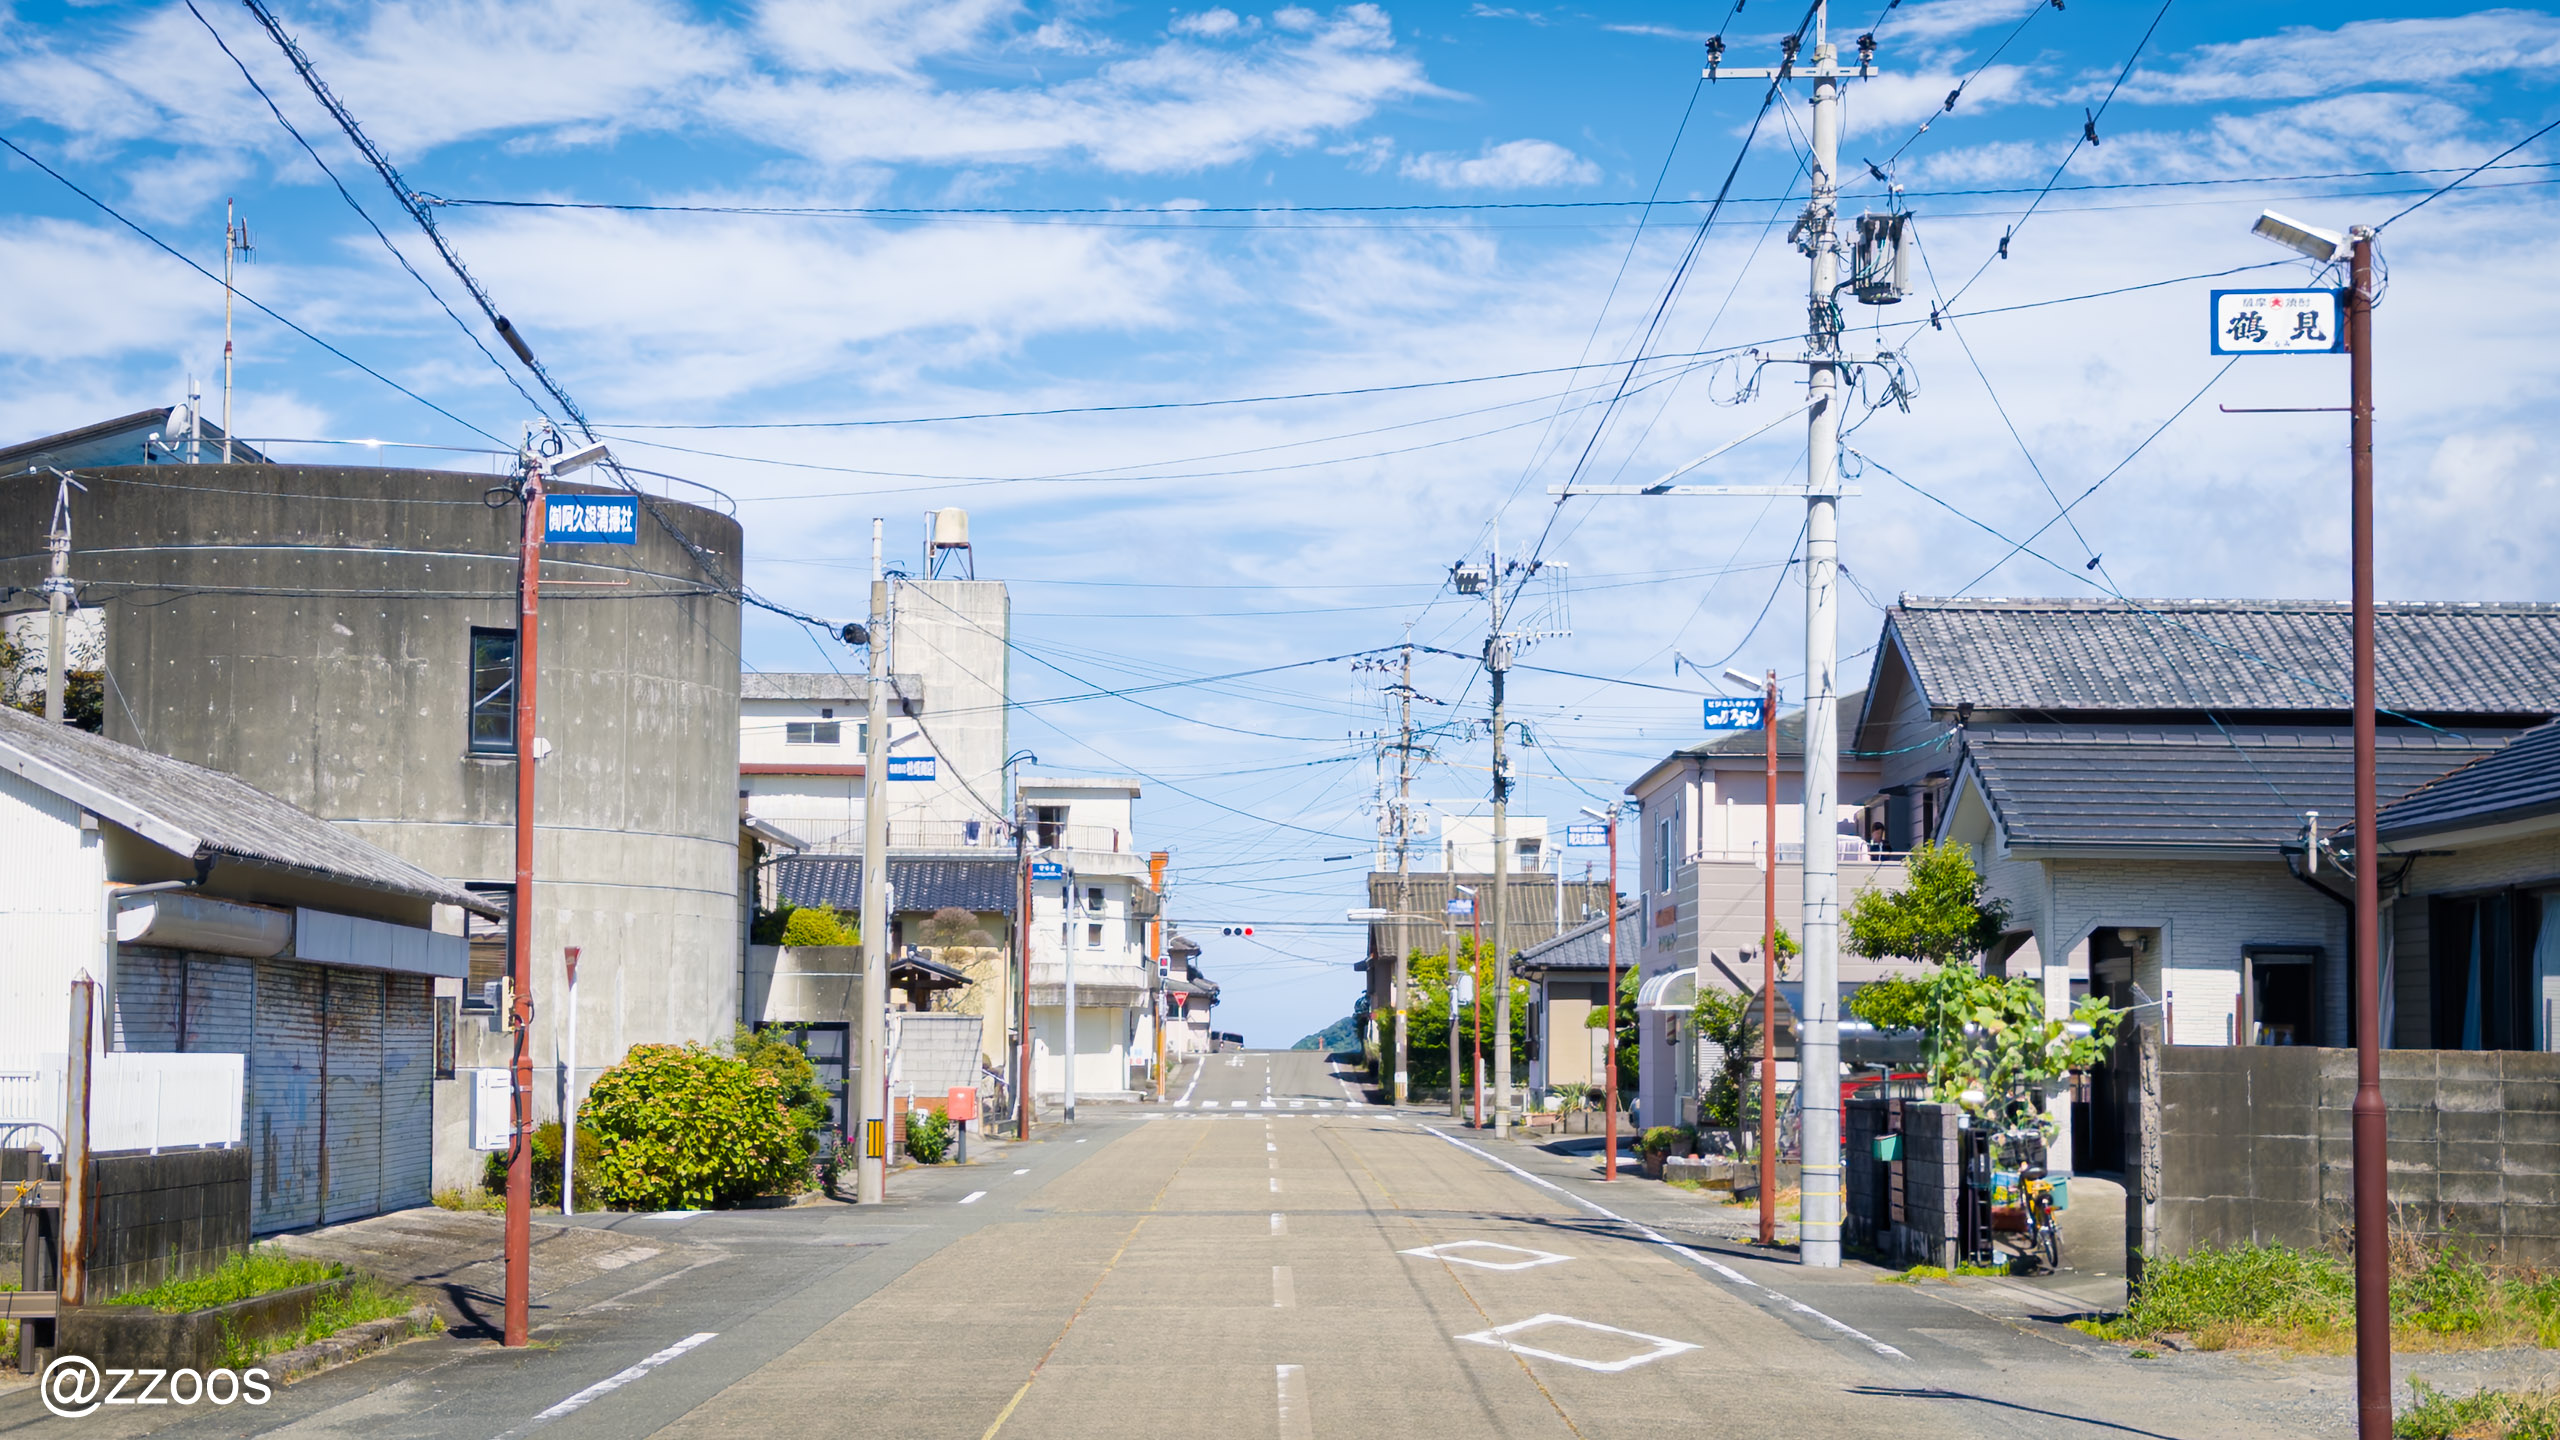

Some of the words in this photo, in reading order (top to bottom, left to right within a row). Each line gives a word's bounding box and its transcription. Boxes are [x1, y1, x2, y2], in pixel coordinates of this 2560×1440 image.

[2226, 310, 2327, 342] 鶴見
[1707, 700, 1756, 708] ビジネスホテル
